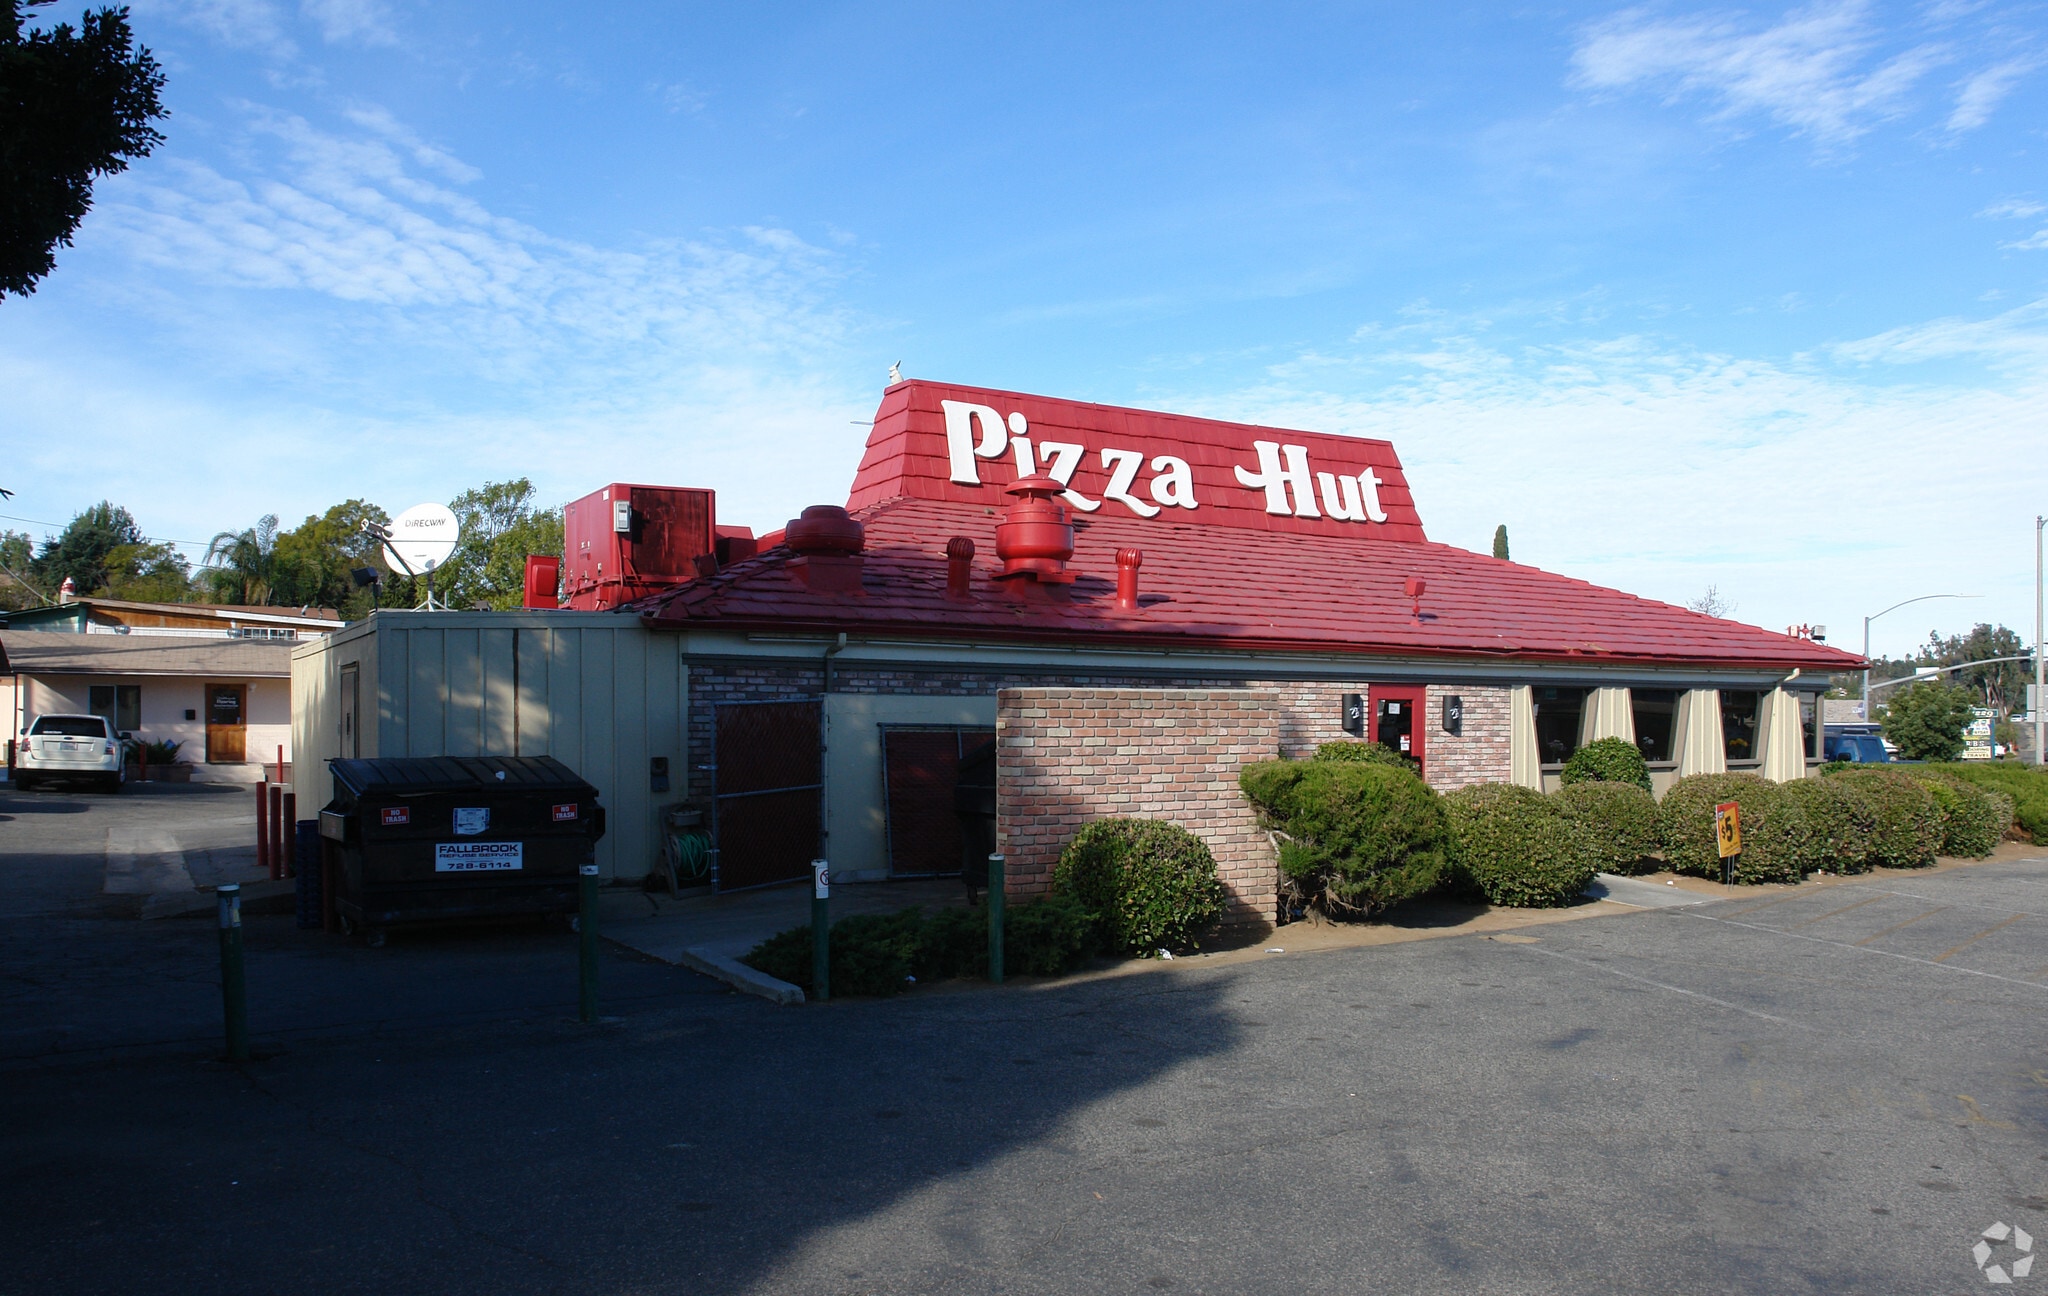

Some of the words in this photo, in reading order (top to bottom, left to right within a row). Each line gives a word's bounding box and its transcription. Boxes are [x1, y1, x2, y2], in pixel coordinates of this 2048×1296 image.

[941, 399, 1199, 518] Pizza
[1234, 440, 1388, 523] Hut
[385, 815, 407, 823] TRASH
[556, 811, 575, 819] TRASH
[1721, 815, 1733, 842] $5
[439, 844, 518, 853] FALLBROOK
